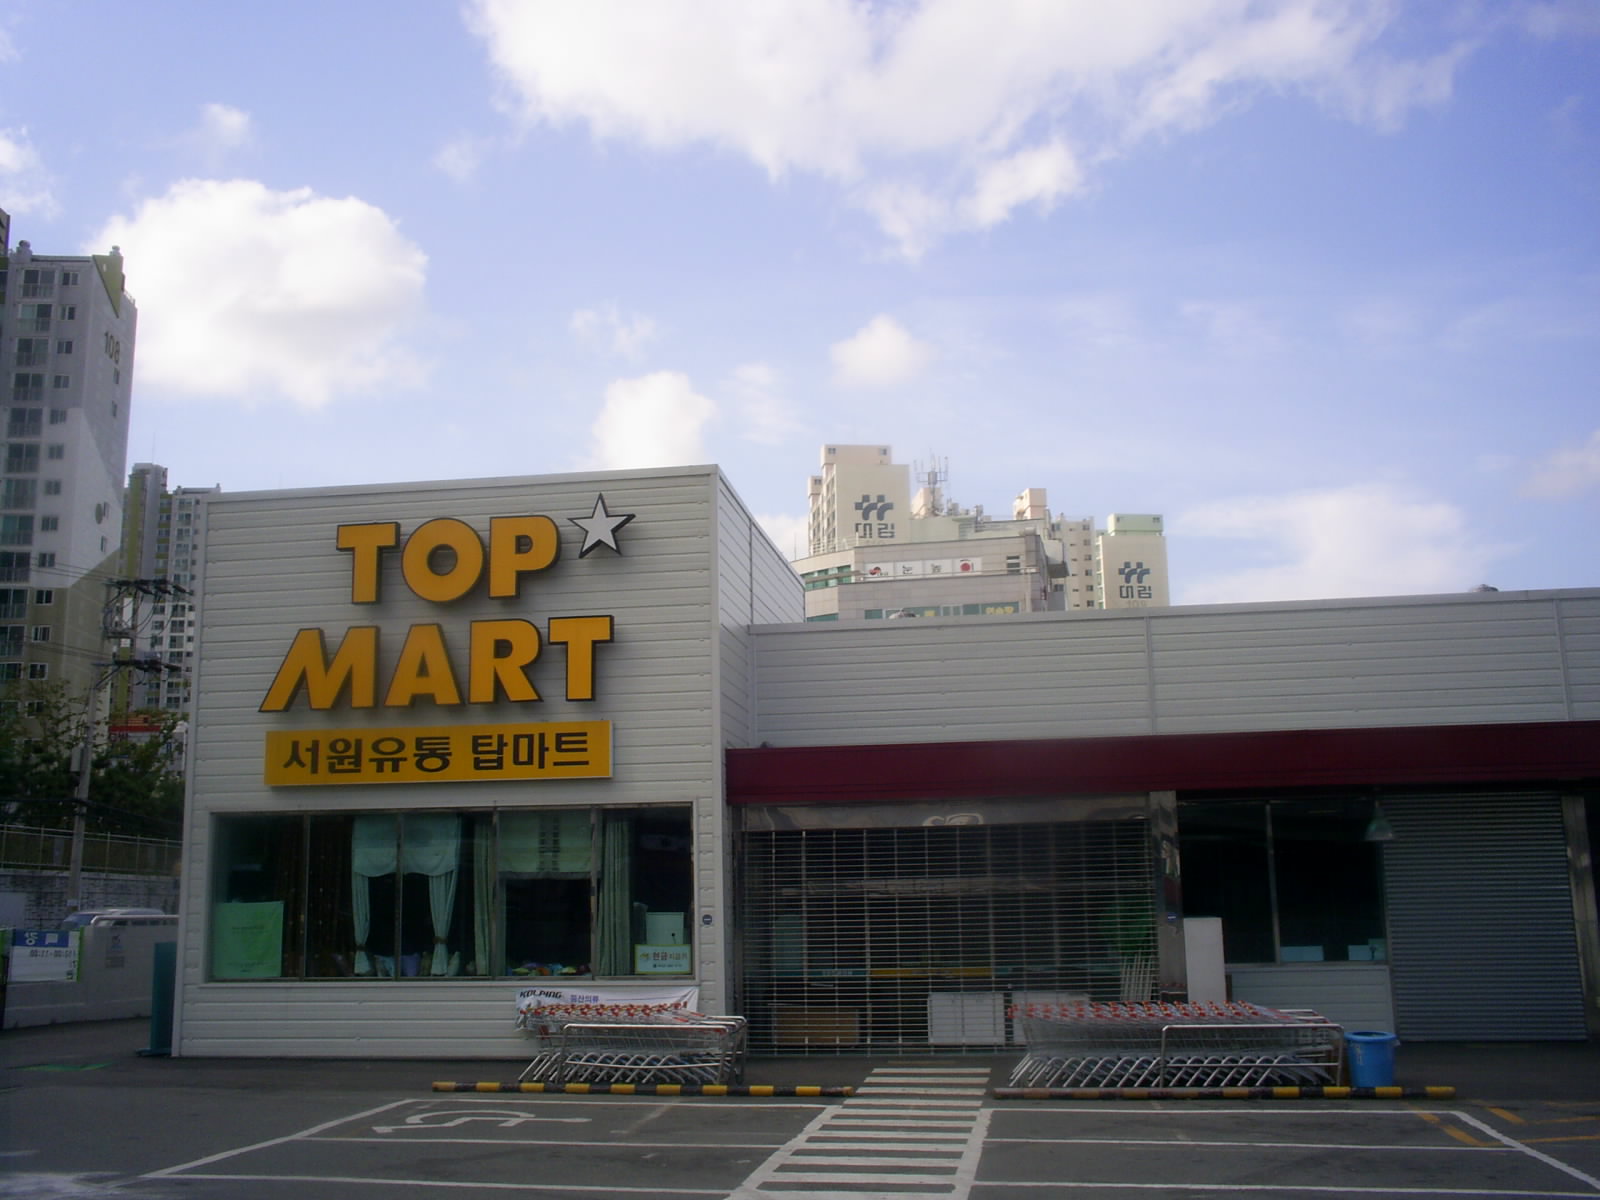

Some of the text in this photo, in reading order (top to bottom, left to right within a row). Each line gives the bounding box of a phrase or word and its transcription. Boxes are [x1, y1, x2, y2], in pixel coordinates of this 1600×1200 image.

[104, 331, 120, 364] 108
[855, 523, 895, 538] 대림
[336, 514, 560, 604] TOP
[1119, 585, 1152, 599] 대림
[258, 614, 614, 712] MART
[283, 731, 590, 774] 서원유통 탑마트
[519, 989, 563, 999] KOLPING
